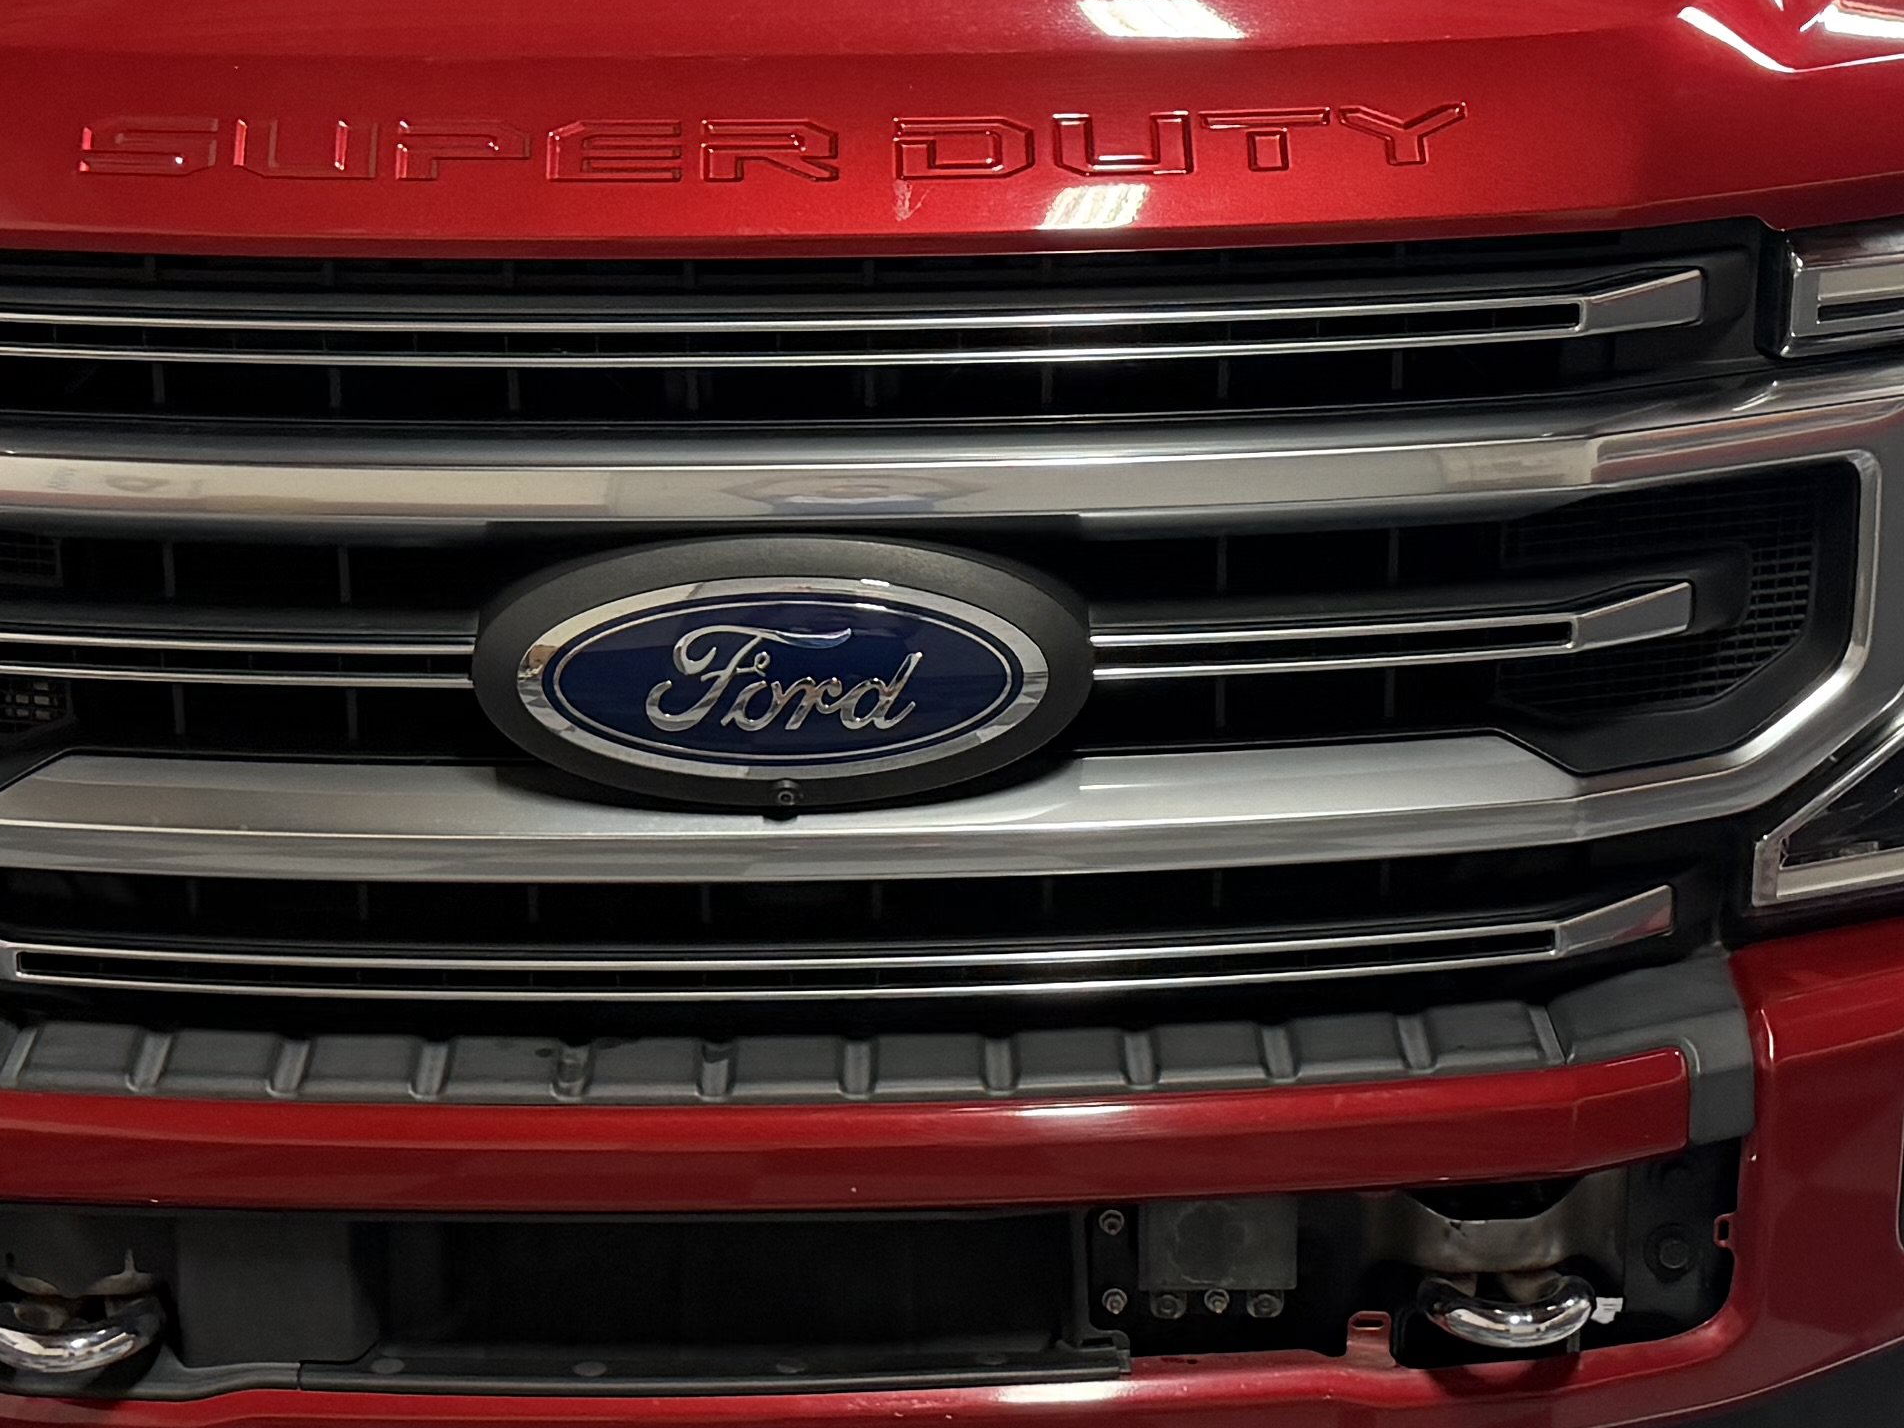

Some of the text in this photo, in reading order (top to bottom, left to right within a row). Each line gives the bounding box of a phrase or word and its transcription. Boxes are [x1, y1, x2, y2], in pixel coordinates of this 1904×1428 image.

[79, 101, 1467, 183] SUPER DUTY
[646, 625, 923, 732] Ford
